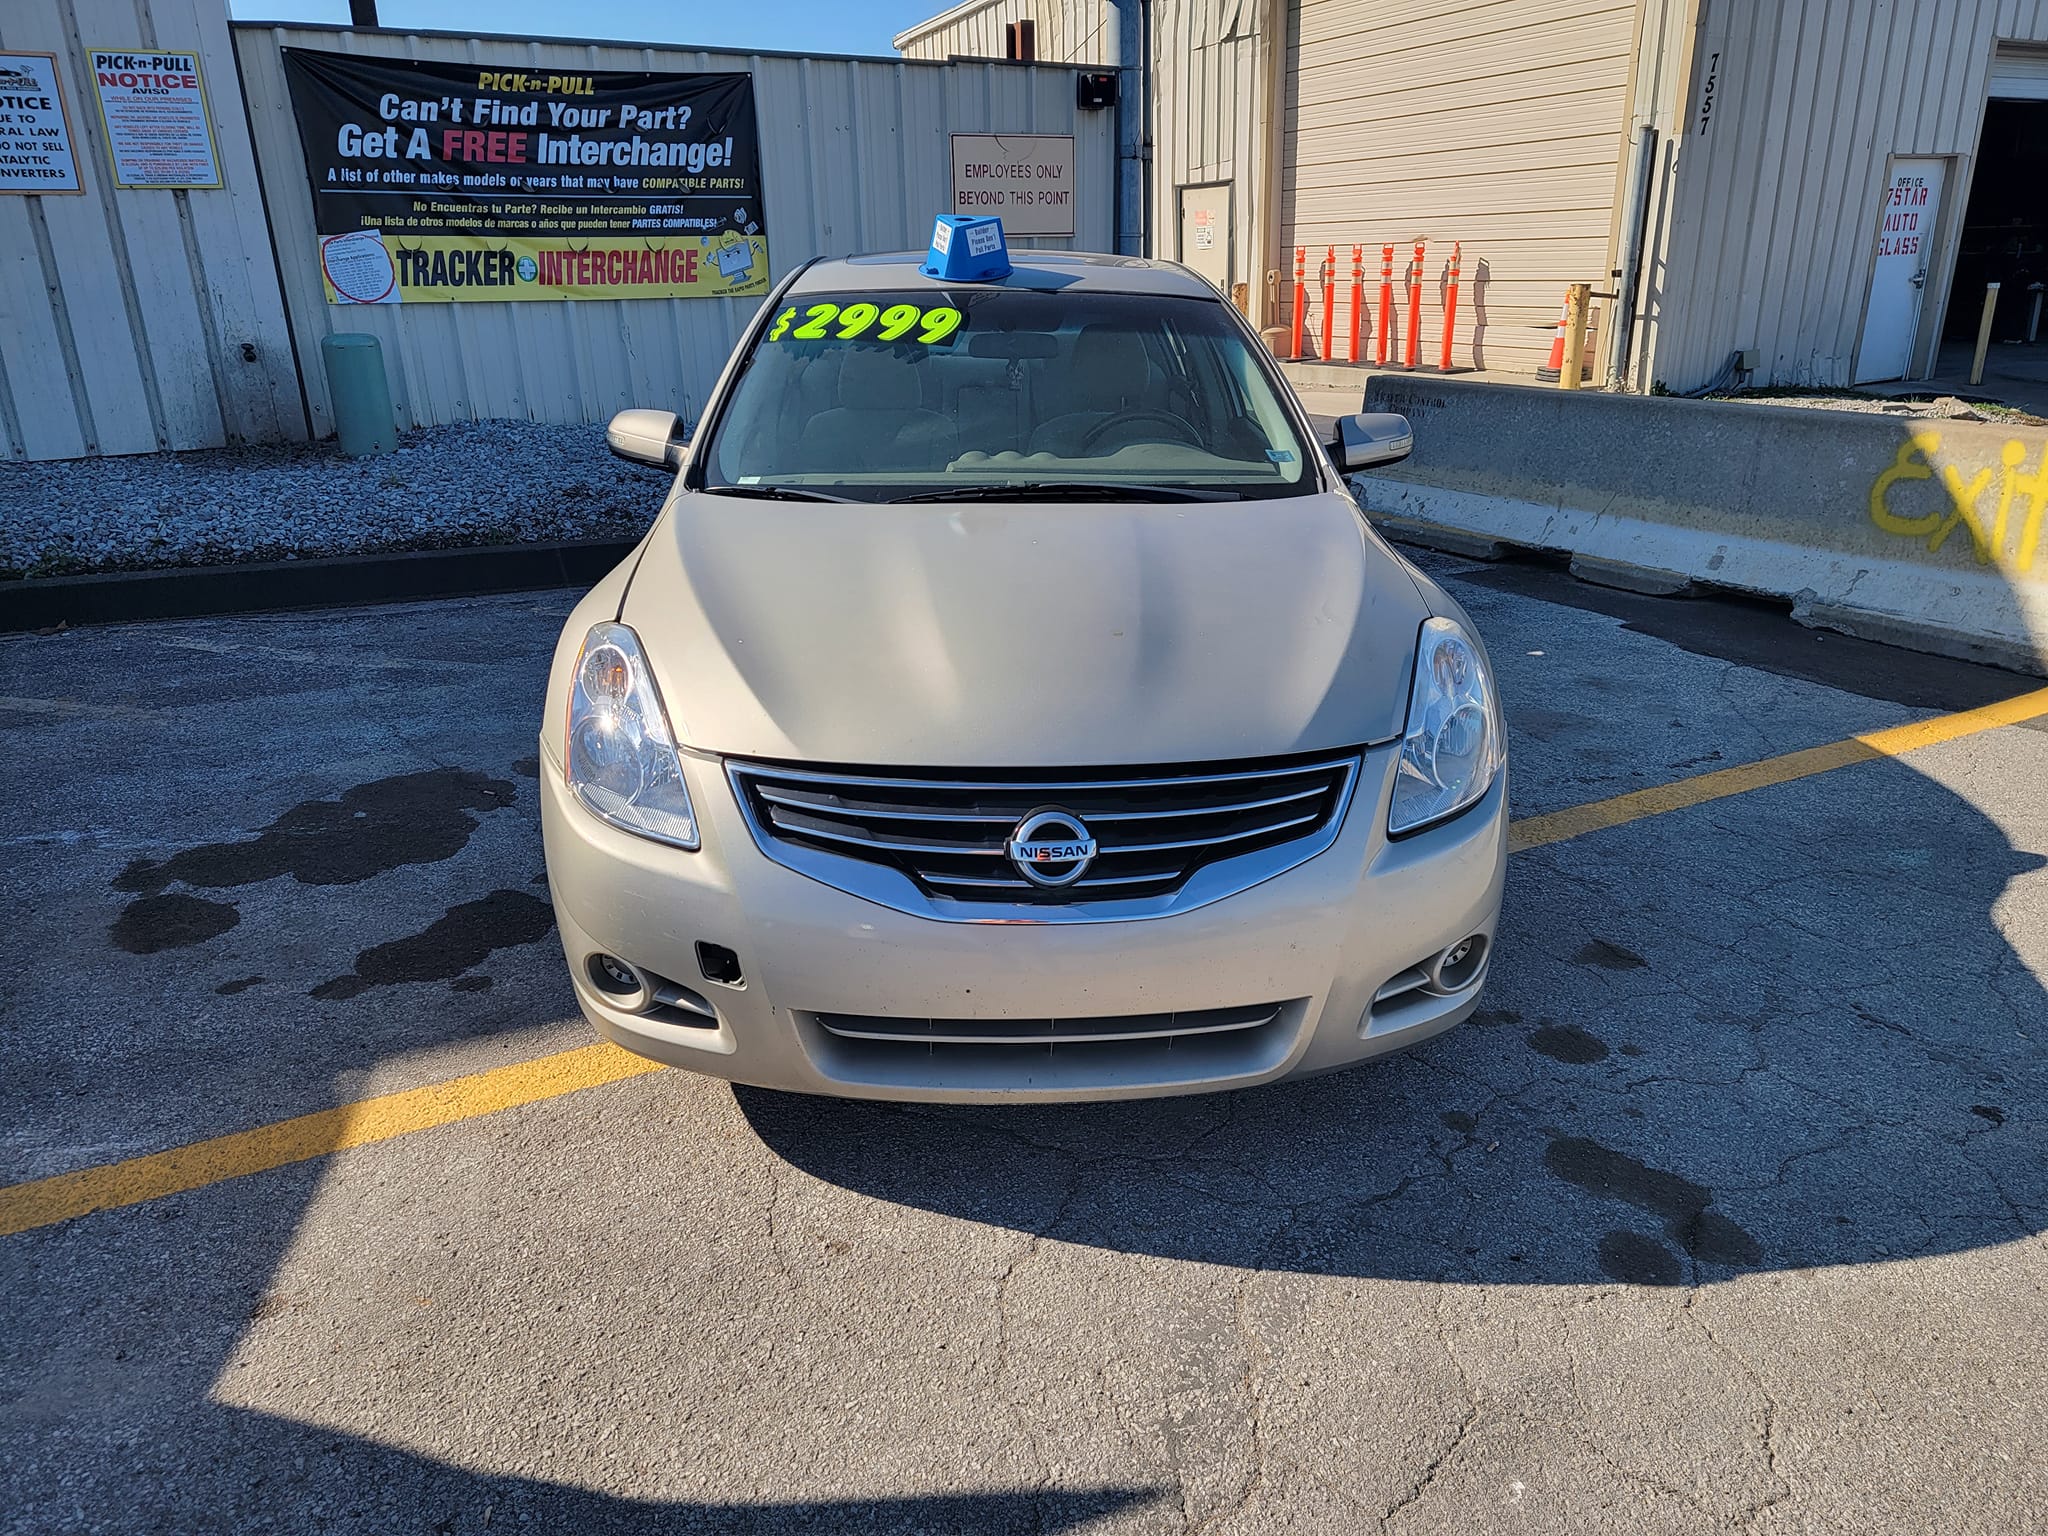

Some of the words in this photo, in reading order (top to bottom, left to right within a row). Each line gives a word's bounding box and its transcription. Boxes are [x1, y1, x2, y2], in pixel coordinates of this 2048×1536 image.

[96, 55, 192, 72] PICK-n-PULL
[97, 72, 198, 89] NOTICE
[478, 72, 594, 95] PICK-n-PULL
[1700, 52, 1720, 136] 7557
[18, 115, 36, 123] TO
[379, 93, 463, 123] Can't
[473, 98, 538, 126] Find
[547, 102, 612, 128] Your
[618, 104, 692, 130] Part?
[29, 128, 59, 137] LAW
[0, 141, 11, 150] O
[15, 142, 37, 151] NOT
[42, 142, 65, 151] SELL
[337, 123, 399, 159] Get
[405, 127, 432, 160] A
[442, 130, 528, 164] FREE
[537, 132, 734, 174] Interchange!
[328, 168, 336, 182] A
[341, 168, 362, 182] list
[366, 169, 379, 183] of
[383, 170, 416, 184] other
[419, 171, 460, 185] makes
[463, 173, 506, 187] models
[510, 176, 522, 187] or
[525, 177, 557, 190] years
[561, 175, 583, 188] that
[587, 178, 610, 192] may
[614, 176, 639, 189] have
[642, 177, 706, 190] COMPATIBLE
[709, 177, 744, 190] PARTS!
[965, 164, 1032, 179] EMPLOYEES
[1036, 164, 1063, 179] ONLY
[1897, 177, 1924, 188] OFFICE
[959, 191, 1005, 205] BEYOND
[1009, 191, 1034, 205] THIS
[1038, 191, 1070, 205] POINT
[413, 201, 427, 212] No
[430, 202, 489, 214] Encuentras
[491, 203, 502, 214] tu
[505, 203, 537, 214] Parte?
[540, 204, 573, 215] Recibe
[576, 206, 588, 215] un
[590, 204, 647, 215] Intercambio
[649, 204, 684, 215] GRATIS!
[384, 215, 405, 227] lista
[406, 216, 418, 227] de
[420, 217, 444, 227] otros
[446, 217, 483, 228] modelos
[484, 217, 496, 228] de
[497, 219, 530, 228] marcas
[531, 220, 537, 228] o
[538, 218, 559, 229] años
[560, 220, 576, 230] que
[577, 219, 608, 230] pueden
[609, 219, 631, 229] tener
[632, 218, 661, 229] PARTES
[662, 218, 717, 229] COMPATIBLES!
[1883, 213, 1918, 232] AUTO
[396, 250, 516, 287] TRACKER
[538, 249, 698, 286] INTERCHANGE
[769, 303, 962, 344] $2999
[1869, 430, 2048, 574] Exit
[1020, 844, 1088, 858] NISSAN
